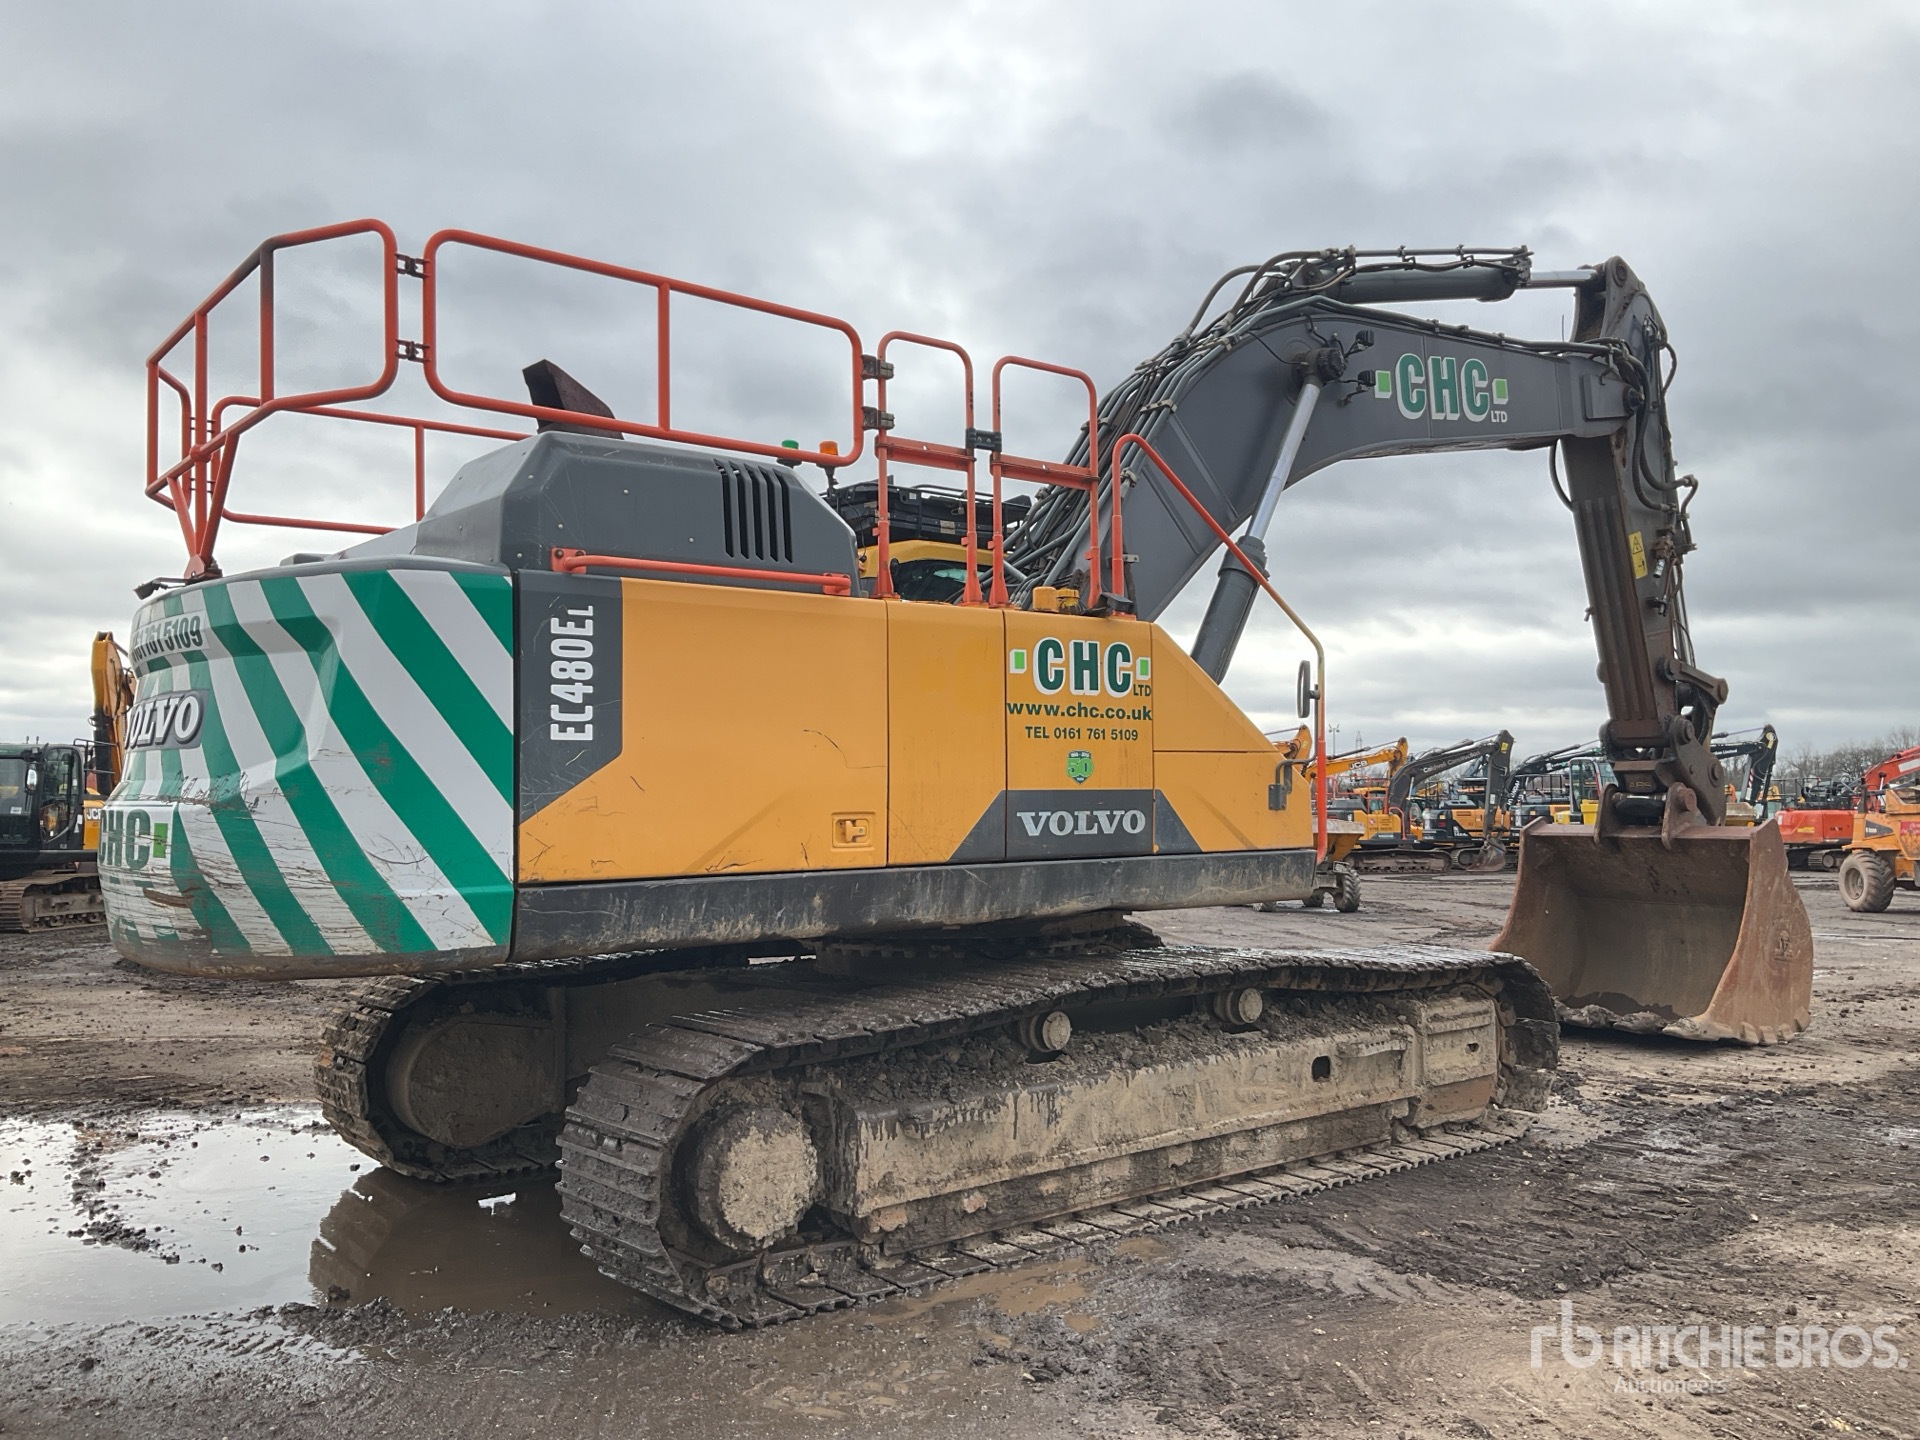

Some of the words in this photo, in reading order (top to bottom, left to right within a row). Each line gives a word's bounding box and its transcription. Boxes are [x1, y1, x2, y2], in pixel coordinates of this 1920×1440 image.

[1395, 353, 1490, 422] CHC
[1491, 411, 1508, 423] LTD
[163, 616, 203, 651] 5109
[550, 605, 594, 741] EC480EL
[1033, 637, 1132, 697] CHC
[1133, 684, 1152, 697] LTD
[1007, 702, 1152, 720] www.chc.co.uk
[1025, 726, 1050, 739] TEL
[1053, 727, 1081, 740] 0161
[1086, 728, 1106, 740] 761
[1110, 729, 1138, 740] 5109
[1350, 760, 1368, 770] JCB
[1017, 810, 1146, 836] VOLVO
